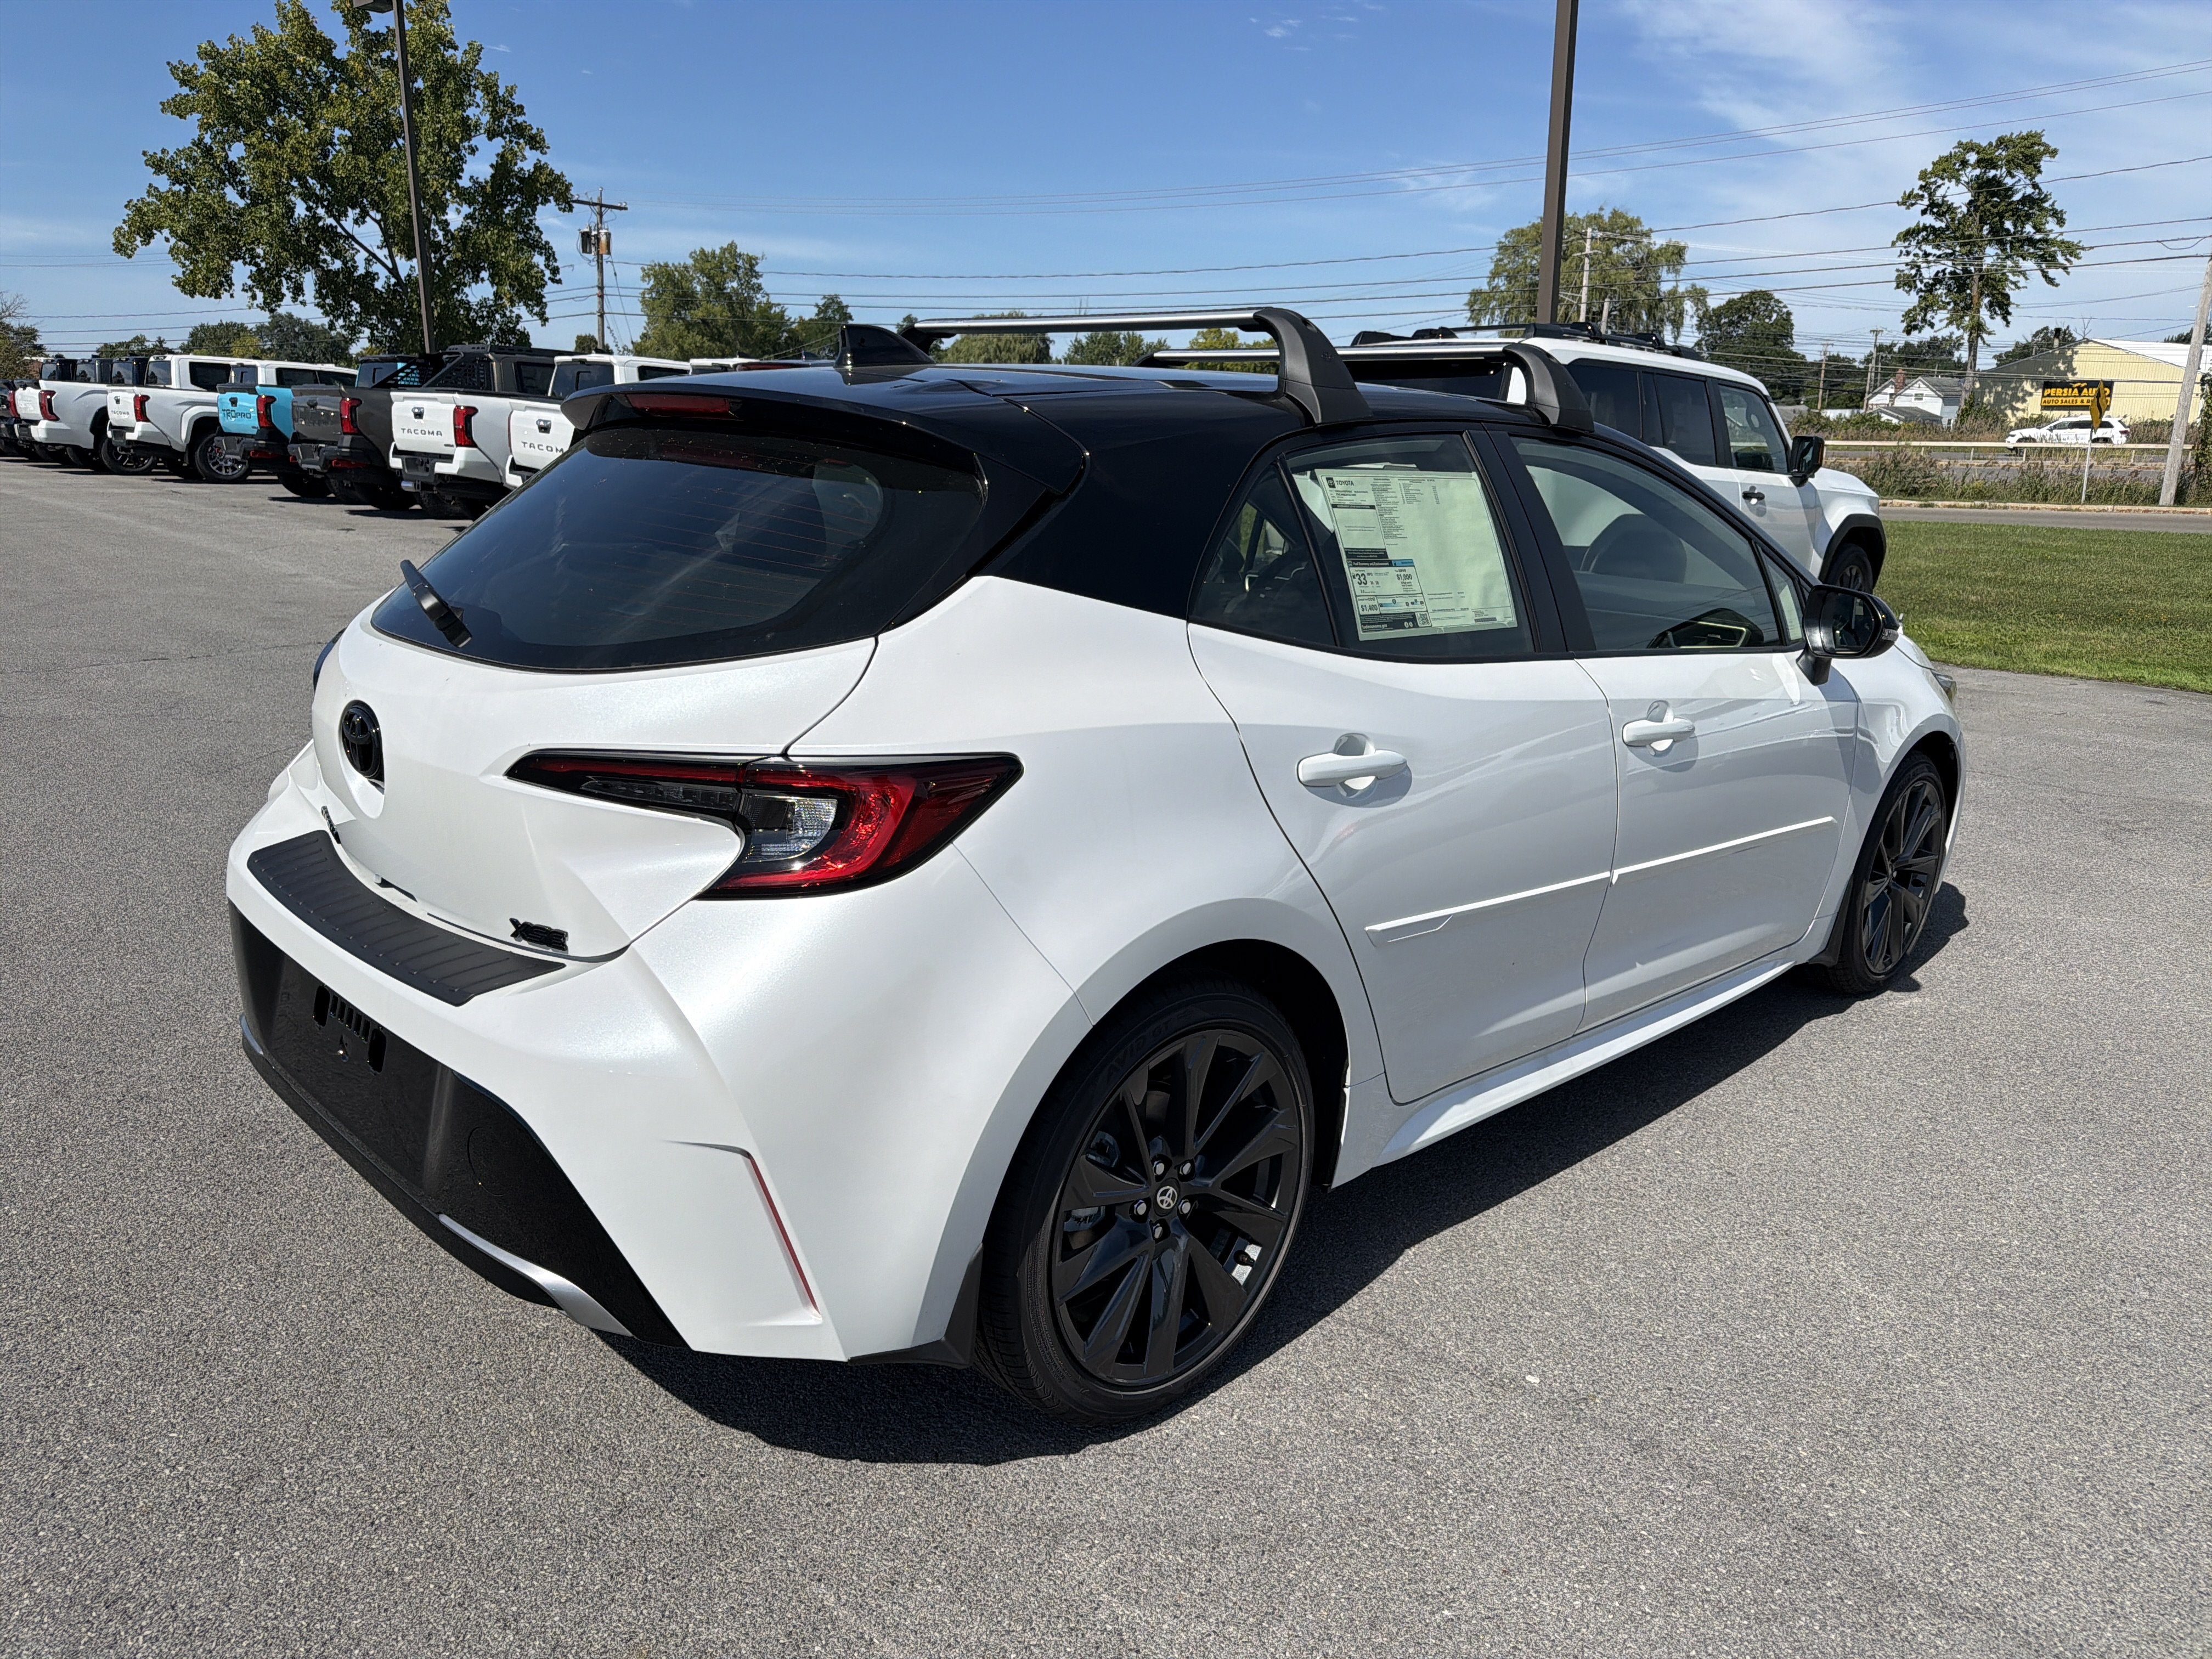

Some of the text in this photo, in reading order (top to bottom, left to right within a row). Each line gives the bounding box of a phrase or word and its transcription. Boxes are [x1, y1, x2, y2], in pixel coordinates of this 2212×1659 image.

[2044, 387, 2110, 396] PERSIA AUO
[401, 428, 443, 437] TACOMA
[521, 441, 565, 454] TACOM
[1356, 573, 1368, 585] 33
[509, 917, 568, 951] XSE
